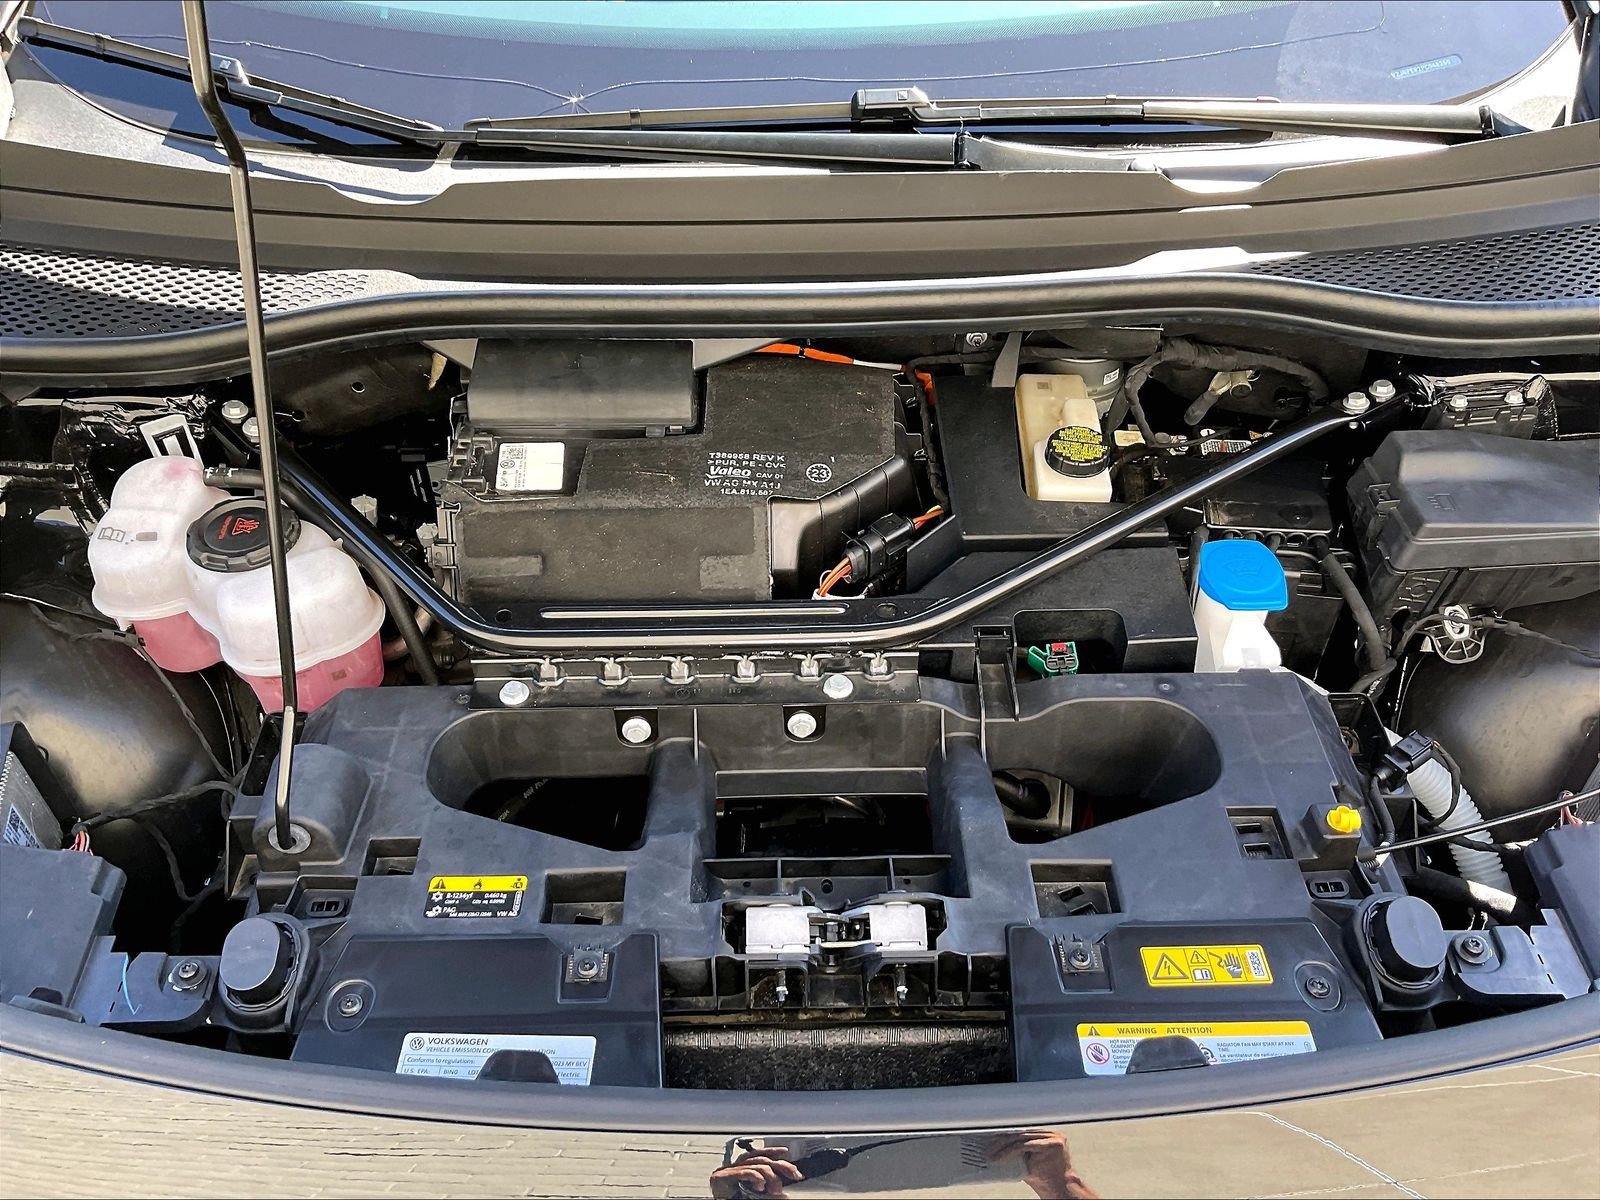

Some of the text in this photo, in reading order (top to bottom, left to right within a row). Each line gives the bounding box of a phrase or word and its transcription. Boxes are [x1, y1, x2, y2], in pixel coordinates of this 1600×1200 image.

[709, 465, 752, 477] Valeo
[811, 469, 827, 478] 23
[1166, 1026, 1212, 1034] ATTENTION
[428, 1037, 489, 1046] VOLKSWAGEN
[451, 1046, 482, 1054] EMISSION
